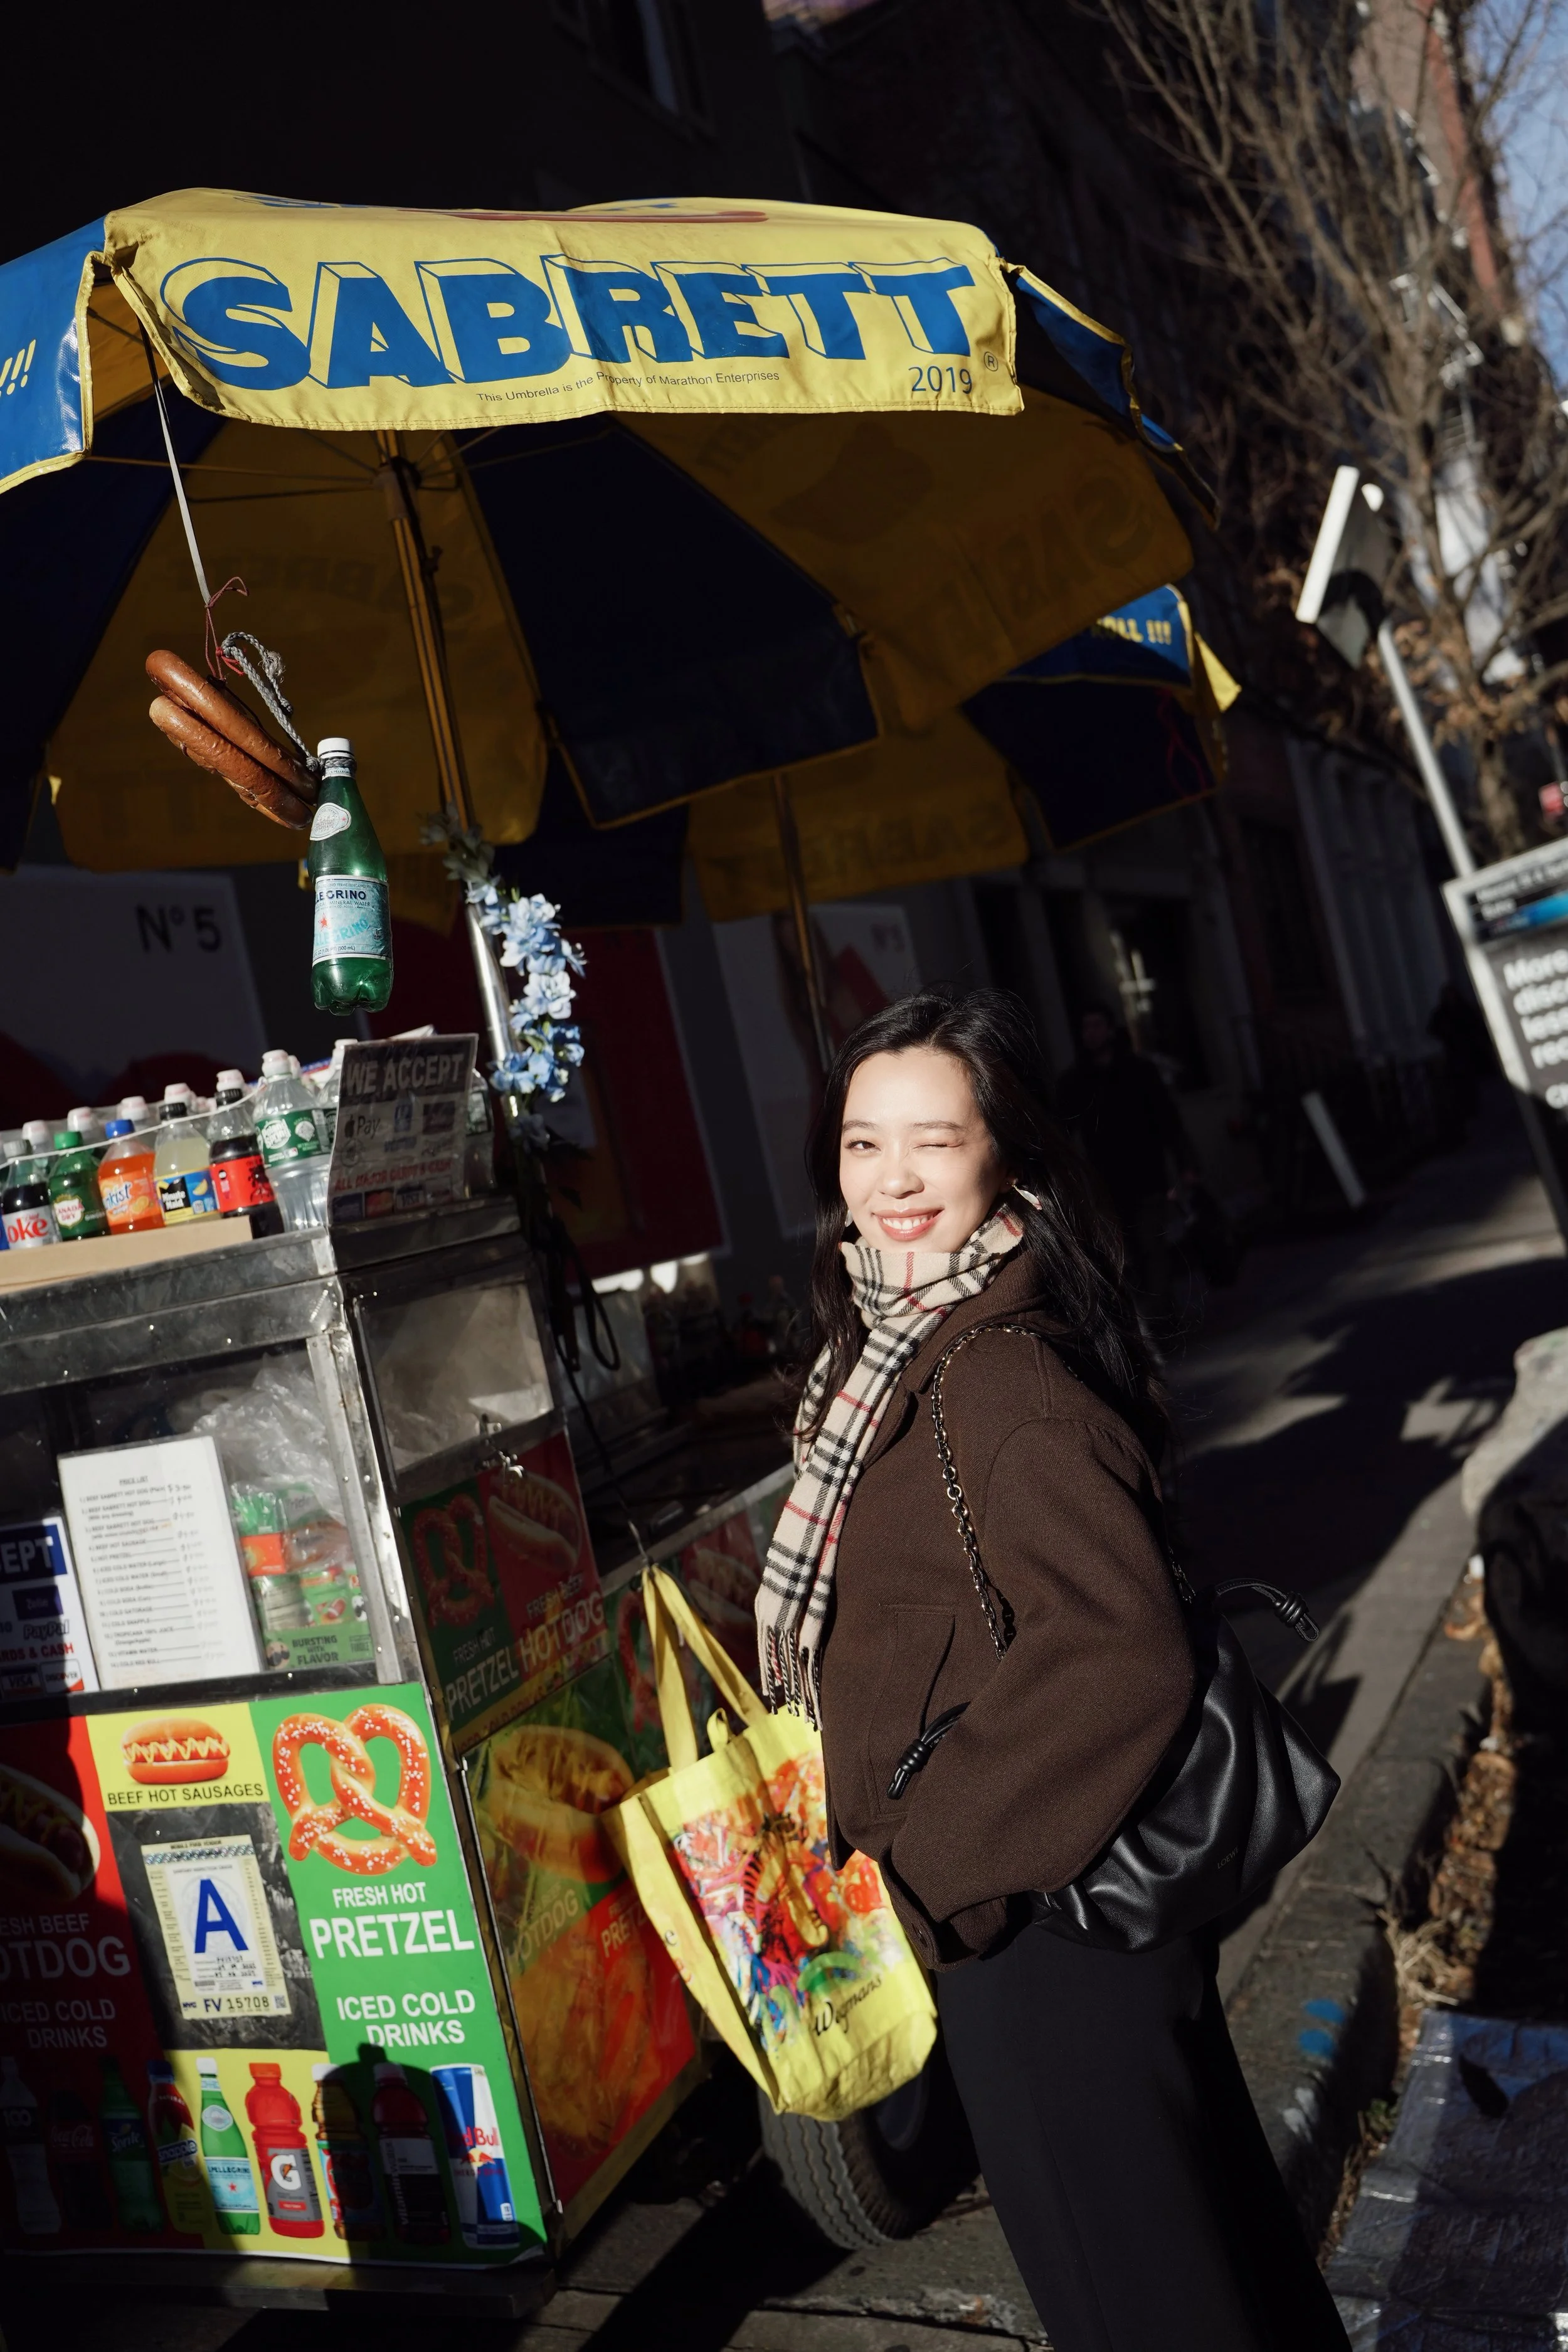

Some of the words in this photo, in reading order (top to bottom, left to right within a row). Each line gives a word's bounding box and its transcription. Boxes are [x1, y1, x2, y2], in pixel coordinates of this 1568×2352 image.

[161, 253, 975, 390] SABRETT
[476, 392, 502, 402] This
[506, 386, 559, 401] Umbrella
[563, 383, 573, 392] is
[576, 375, 594, 389] the
[596, 371, 642, 388] Property
[646, 375, 657, 384] of
[659, 375, 712, 386] Marathon
[716, 371, 780, 384] Enterprises
[908, 366, 972, 394] 2019
[346, 1059, 379, 1096] WE
[382, 1054, 465, 1093] ACCEPT
[357, 1115, 380, 1140] Pay
[23, 1619, 70, 1641] PayPal
[292, 1634, 337, 1648] BURSTING
[41, 1643, 74, 1658] CASH
[297, 1652, 339, 1665] FLAVOR
[453, 1638, 479, 1666] FRESH
[8, 1675, 33, 1688] VISA
[444, 1646, 519, 1721] PRETZEL
[108, 1791, 144, 1804] BEEF
[149, 1789, 176, 1802] HOT
[182, 1784, 263, 1801] SAUSAGES
[332, 1885, 389, 1909] FRESH
[390, 1882, 426, 1904] HOT
[38, 1913, 90, 1934] BEEF
[194, 1878, 249, 1953] A
[309, 1909, 475, 1959] PRETZEL
[55, 1998, 117, 2021] COLD
[204, 1998, 221, 2013] FV
[227, 1996, 269, 2009] 15708
[336, 1995, 396, 2021] ICED
[401, 1989, 475, 2018] COLD
[812, 1974, 881, 2036] Wegmans
[27, 2025, 108, 2049] DRINKS
[366, 2020, 465, 2048] DRINKS
[110, 2131, 140, 2153] Sprite
[475, 2127, 500, 2146] Bull
[270, 2154, 302, 2191] G
